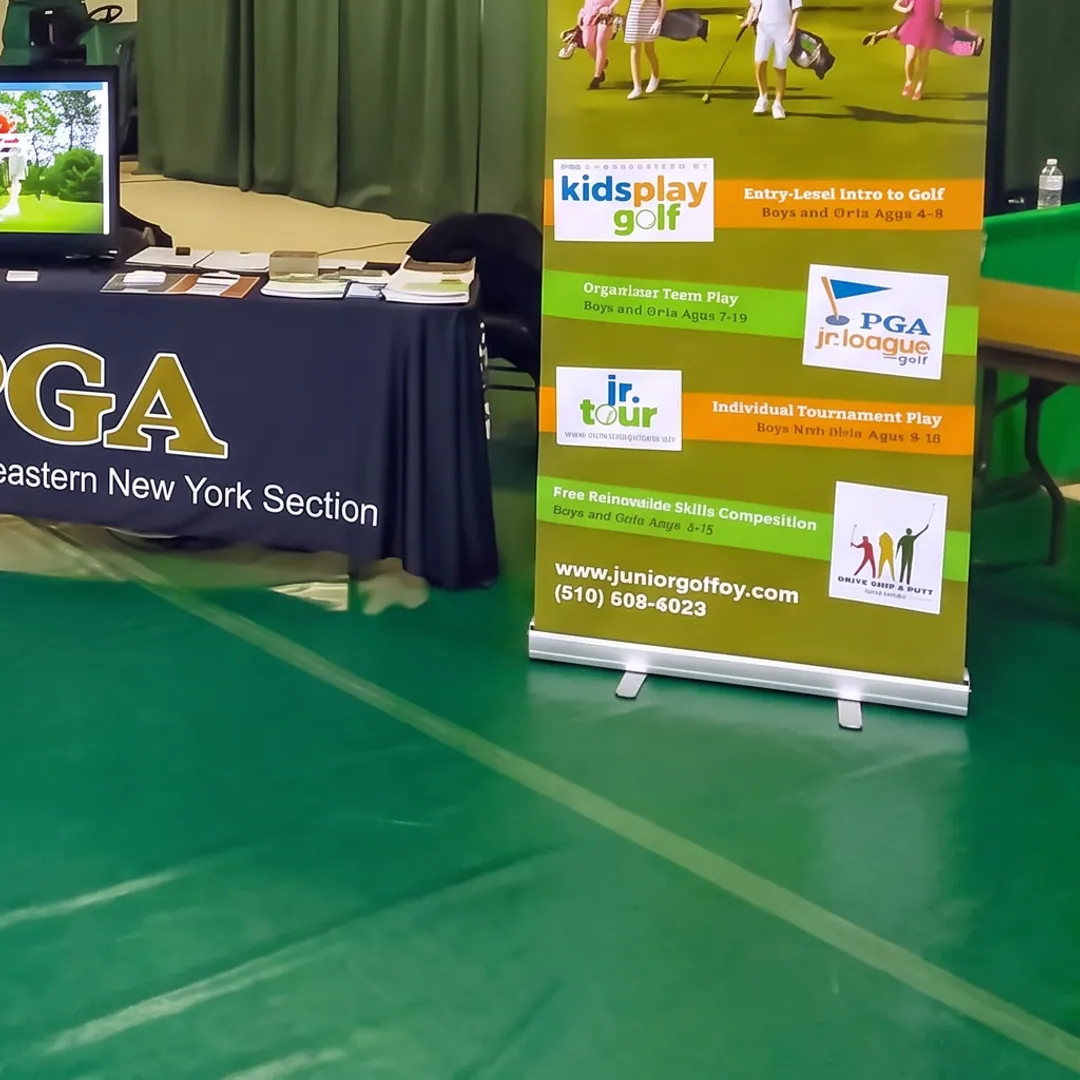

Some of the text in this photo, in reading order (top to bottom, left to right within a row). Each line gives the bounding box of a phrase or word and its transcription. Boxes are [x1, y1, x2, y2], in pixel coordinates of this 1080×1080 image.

[560, 174, 708, 208] kidsplay
[839, 188, 883, 201] Intro
[886, 188, 904, 201] to
[908, 187, 946, 201] Golf
[613, 203, 682, 236] golf
[761, 207, 796, 221] Boys
[800, 207, 829, 219] and
[662, 288, 703, 302] Teem
[706, 291, 739, 308] Play
[583, 300, 614, 314] Boys
[617, 305, 643, 316] and
[719, 311, 748, 324] 7-19
[860, 312, 931, 337] PGA
[712, 400, 943, 428] Individual Tournament Play
[756, 421, 790, 436] Boys
[107, 466, 176, 503] New
[183, 474, 253, 511] York
[261, 483, 380, 527] Section
[552, 486, 585, 501] Free
[674, 501, 716, 518] Skills
[588, 510, 612, 522] and
[554, 583, 605, 609] (510)
